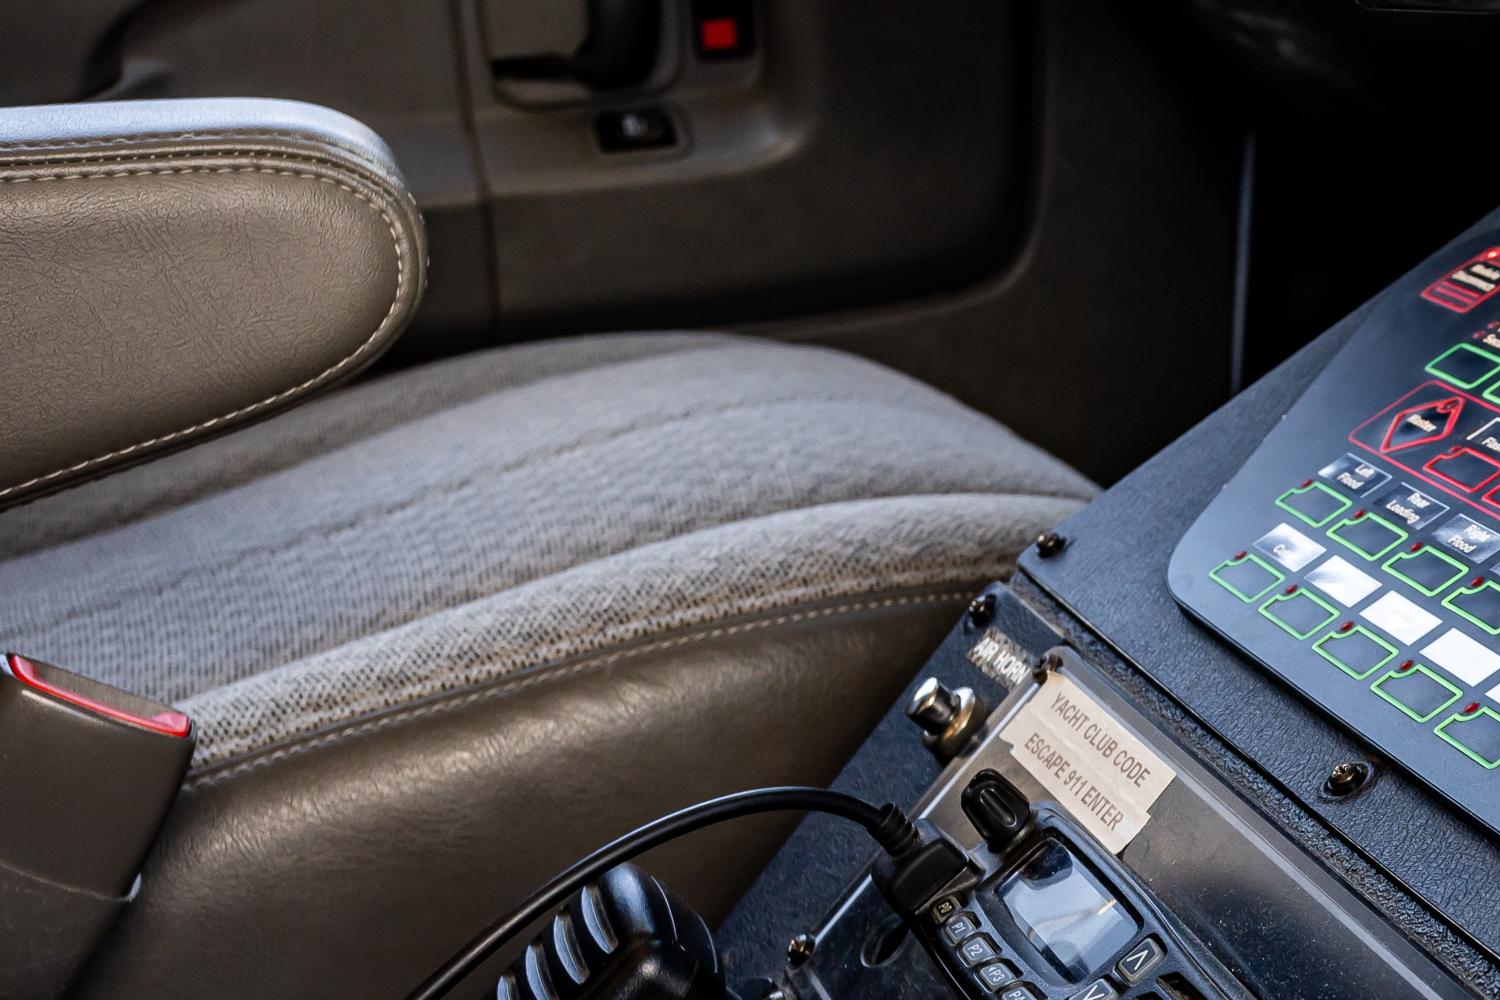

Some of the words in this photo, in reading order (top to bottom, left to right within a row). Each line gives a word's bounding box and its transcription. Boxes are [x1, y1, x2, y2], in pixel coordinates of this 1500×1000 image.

[1336, 472, 1365, 490] Flood
[1407, 492, 1430, 509] Rear
[1386, 499, 1421, 525] Loading
[1448, 534, 1477, 554] Flood
[972, 637, 1000, 662] AIR
[992, 649, 1033, 685] HORN
[1050, 692, 1091, 732] YACHT
[1083, 723, 1118, 758] CLUB
[1112, 750, 1151, 788] CODE
[1024, 732, 1070, 779] ESCAPE
[1063, 770, 1089, 796] 911
[1080, 786, 1124, 831] ENTER
[951, 922, 965, 934] P1
[968, 945, 983, 957] P2
[990, 967, 1005, 982] P3
